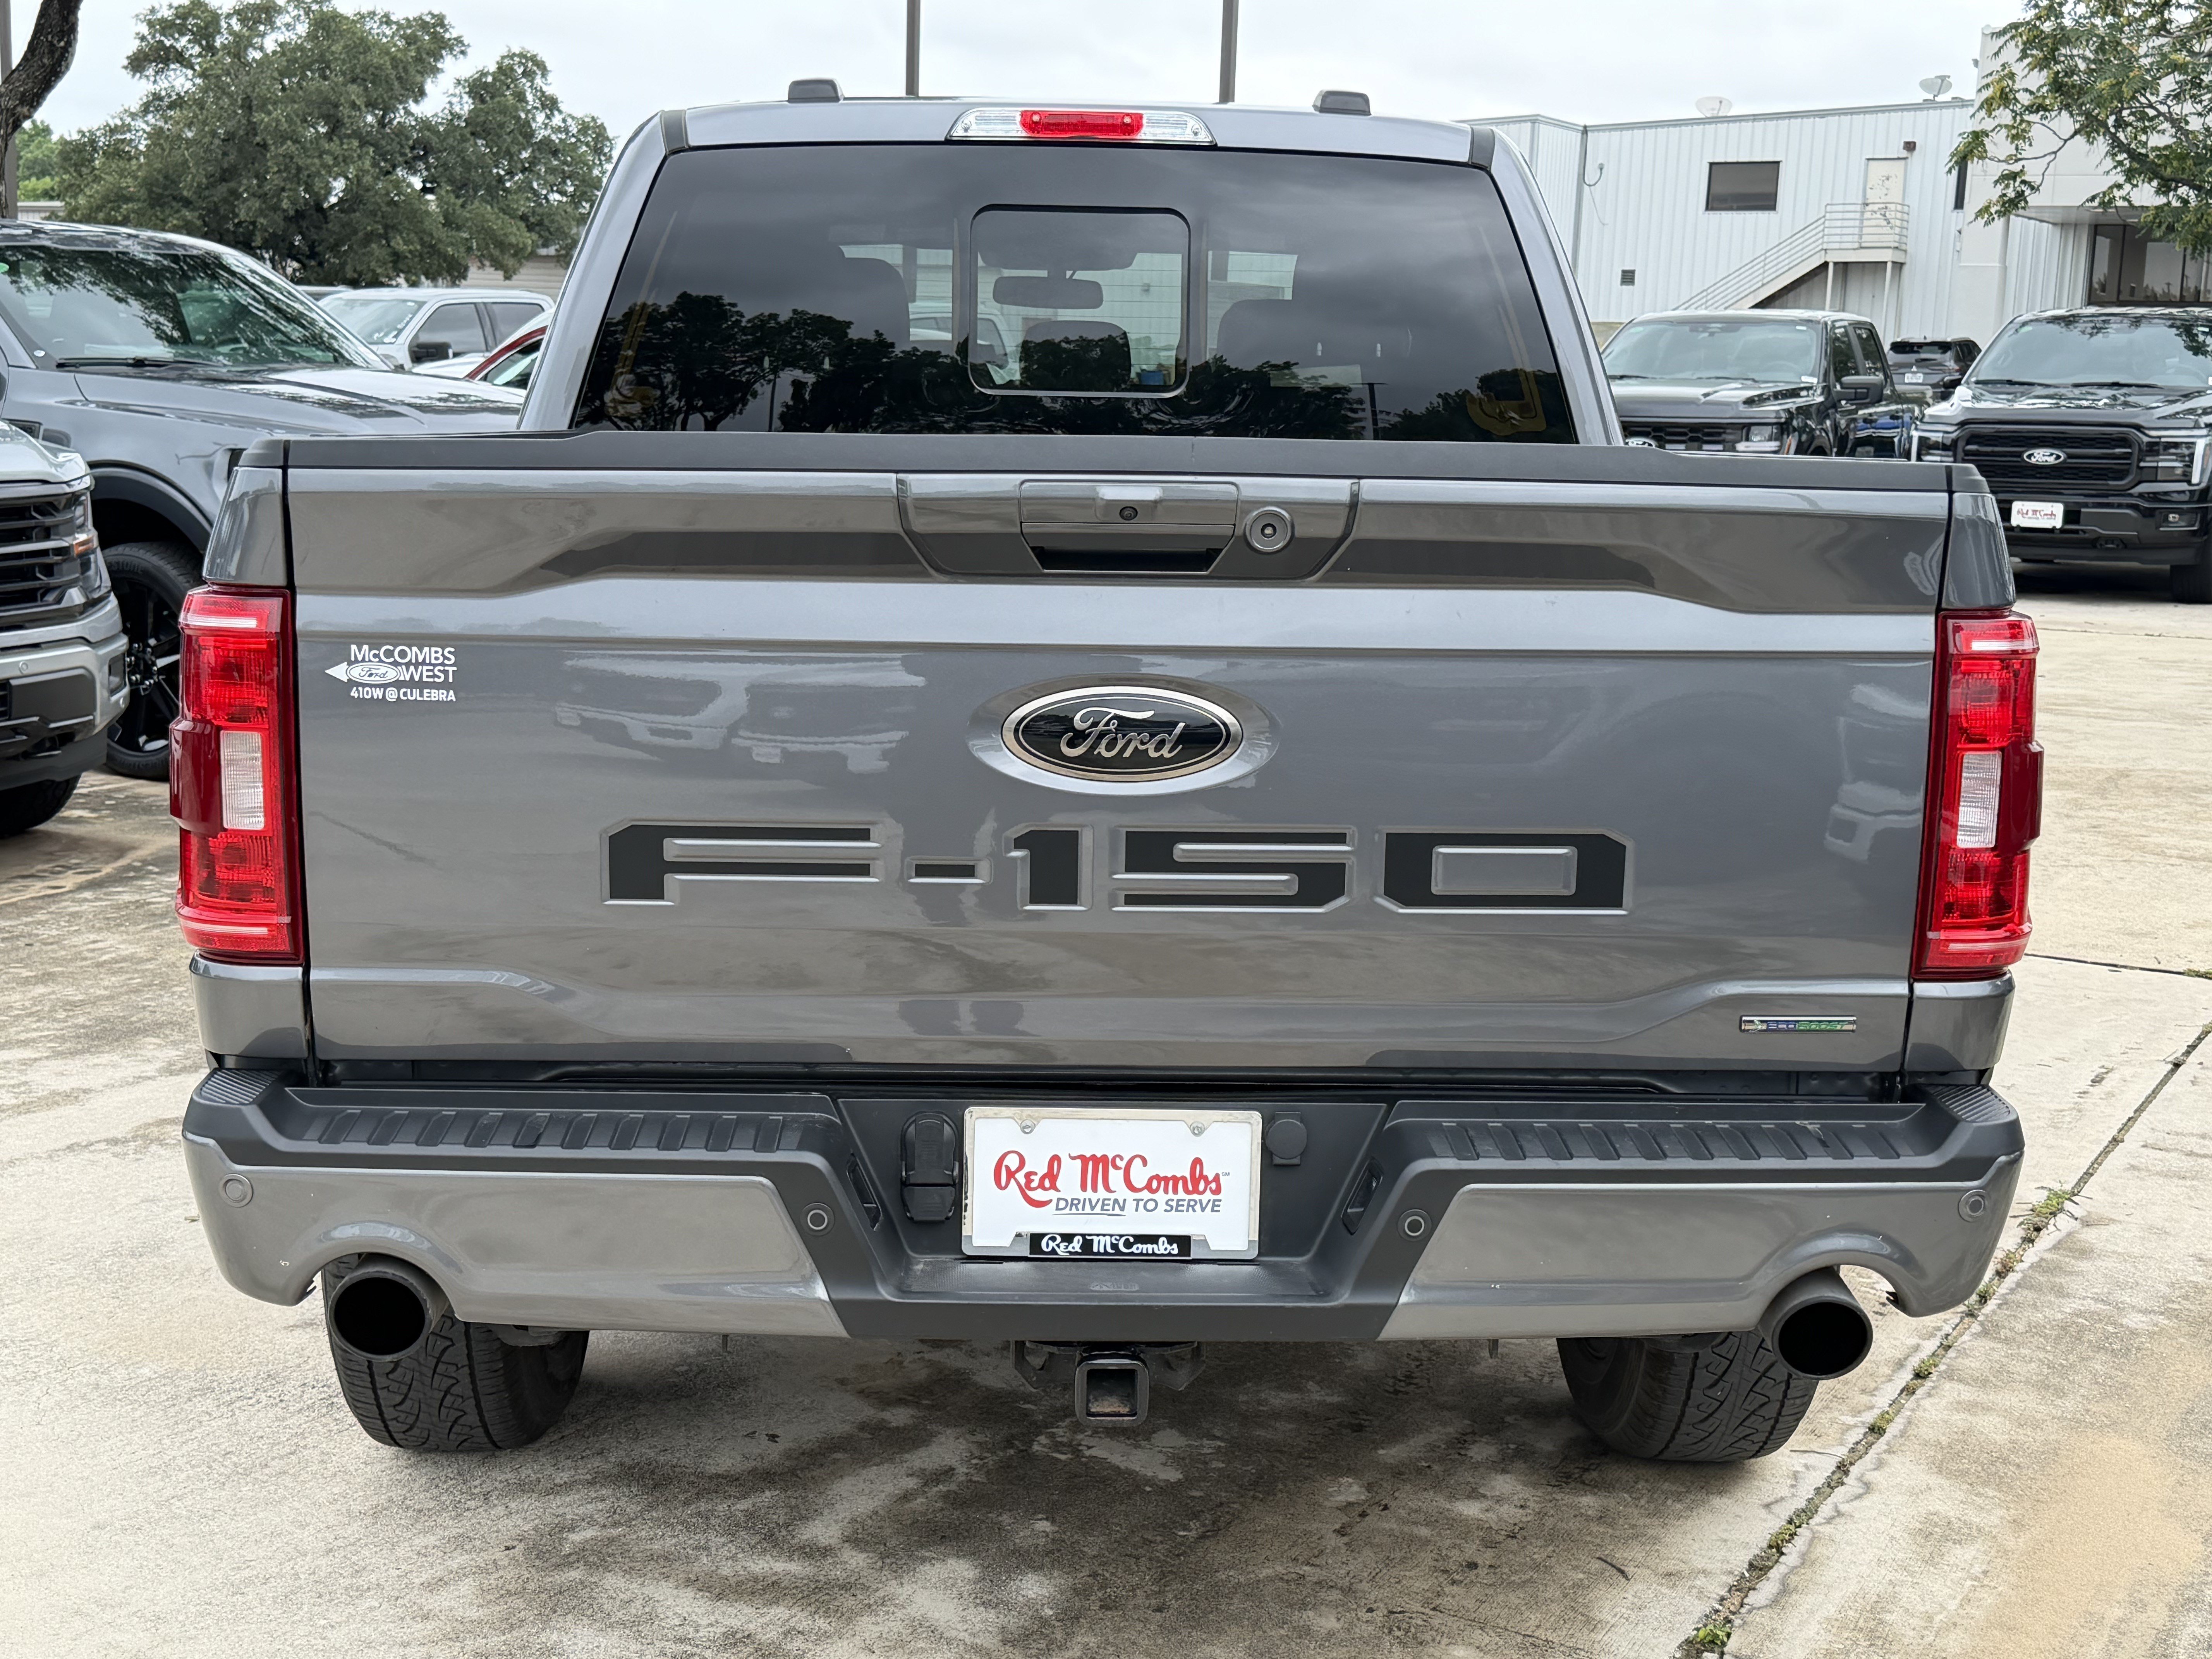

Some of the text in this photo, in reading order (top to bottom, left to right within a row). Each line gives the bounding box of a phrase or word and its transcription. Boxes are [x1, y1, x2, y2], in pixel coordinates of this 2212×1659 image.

[350, 644, 455, 665] McCOMBS
[358, 666, 457, 683] Ford WEST
[350, 687, 384, 699] 410W
[400, 689, 456, 701] CULEBRA
[1060, 707, 1186, 758] Ford
[605, 823, 1629, 912] F-150
[993, 1150, 1062, 1208] Red
[1068, 1152, 1222, 1196] McCombs
[1055, 1197, 1222, 1213] DRIVEN TO SERVE
[1041, 1234, 1179, 1256] Red McCombs
